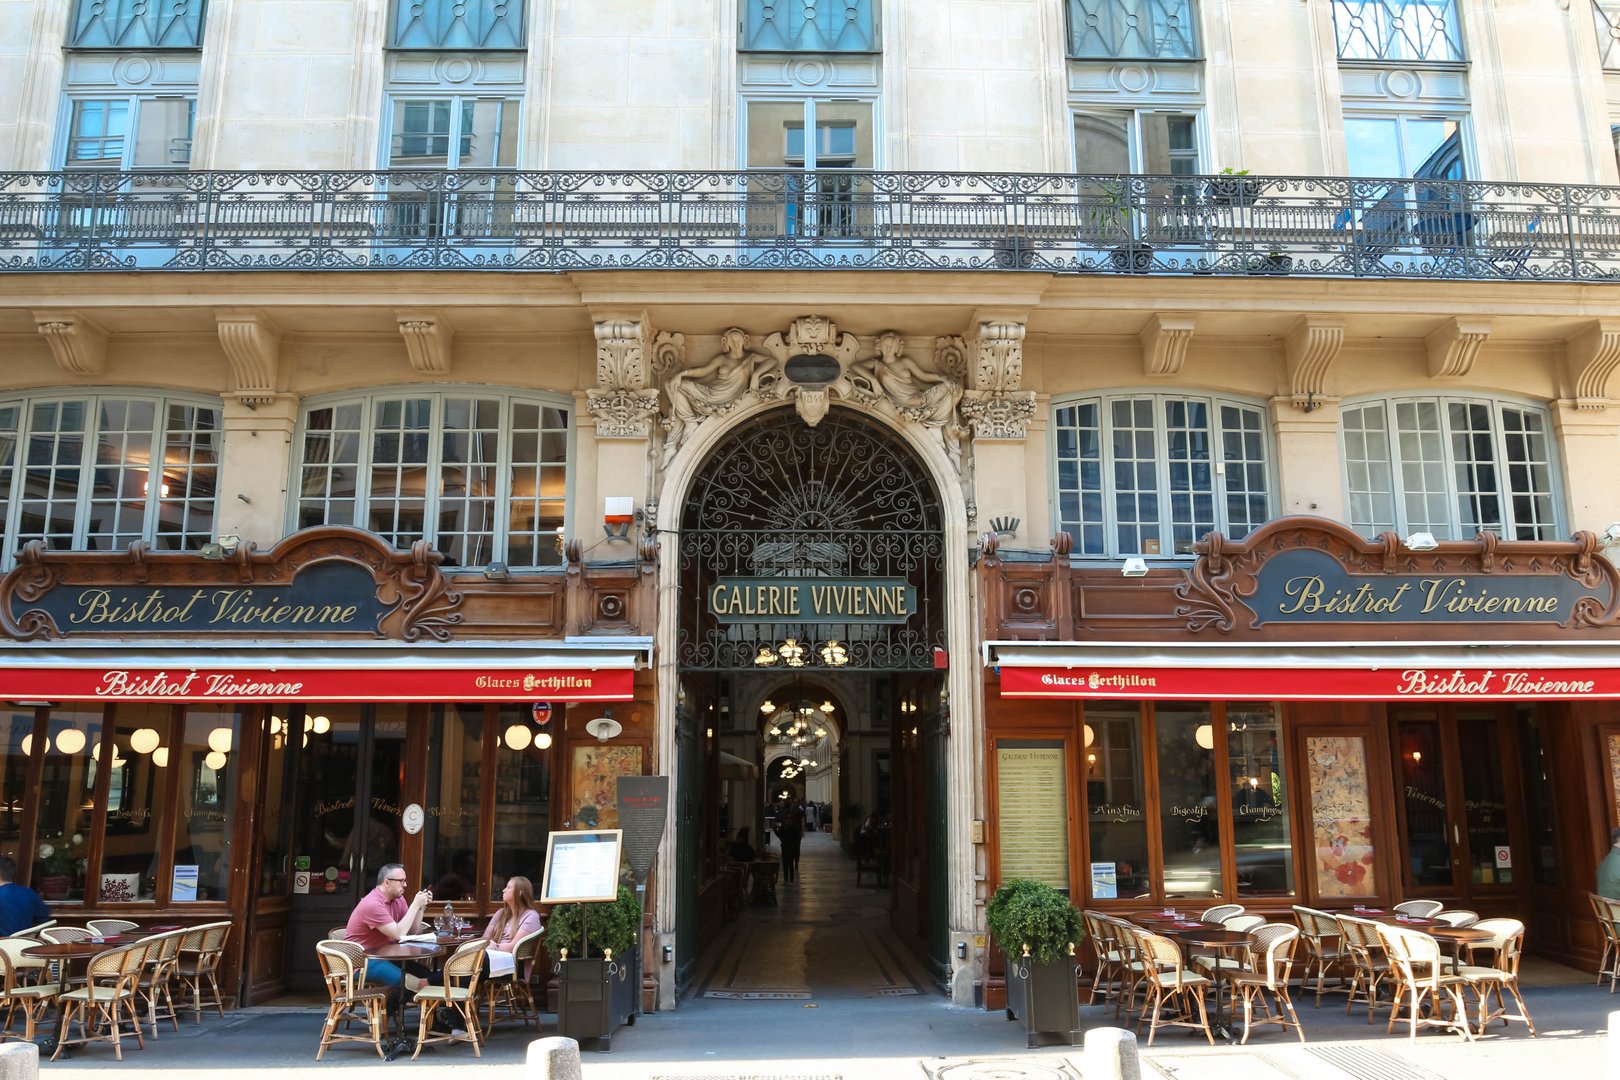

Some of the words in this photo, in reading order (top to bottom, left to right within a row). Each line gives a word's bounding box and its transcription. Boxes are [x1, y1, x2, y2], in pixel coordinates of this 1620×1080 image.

[70, 589, 206, 623] Bistrot
[209, 590, 357, 623] Vivienne
[712, 585, 800, 615] GALERIE
[811, 585, 907, 615] VIVIENNE
[1279, 576, 1412, 615] Bistrot
[1419, 579, 1557, 613] Vivienne
[95, 671, 200, 695] Bistrot
[203, 674, 303, 695] Vivienne
[475, 676, 520, 689] Glaces
[523, 674, 592, 692] Berthillon
[1042, 673, 1085, 686] Glaces
[1088, 672, 1157, 690] Berthillon
[1397, 670, 1497, 694] Bistrot
[1502, 673, 1595, 694] Vivienne
[314, 798, 354, 819] Bistrot
[1405, 786, 1447, 810] Vivienne
[1170, 805, 1208, 818] Digestifs
